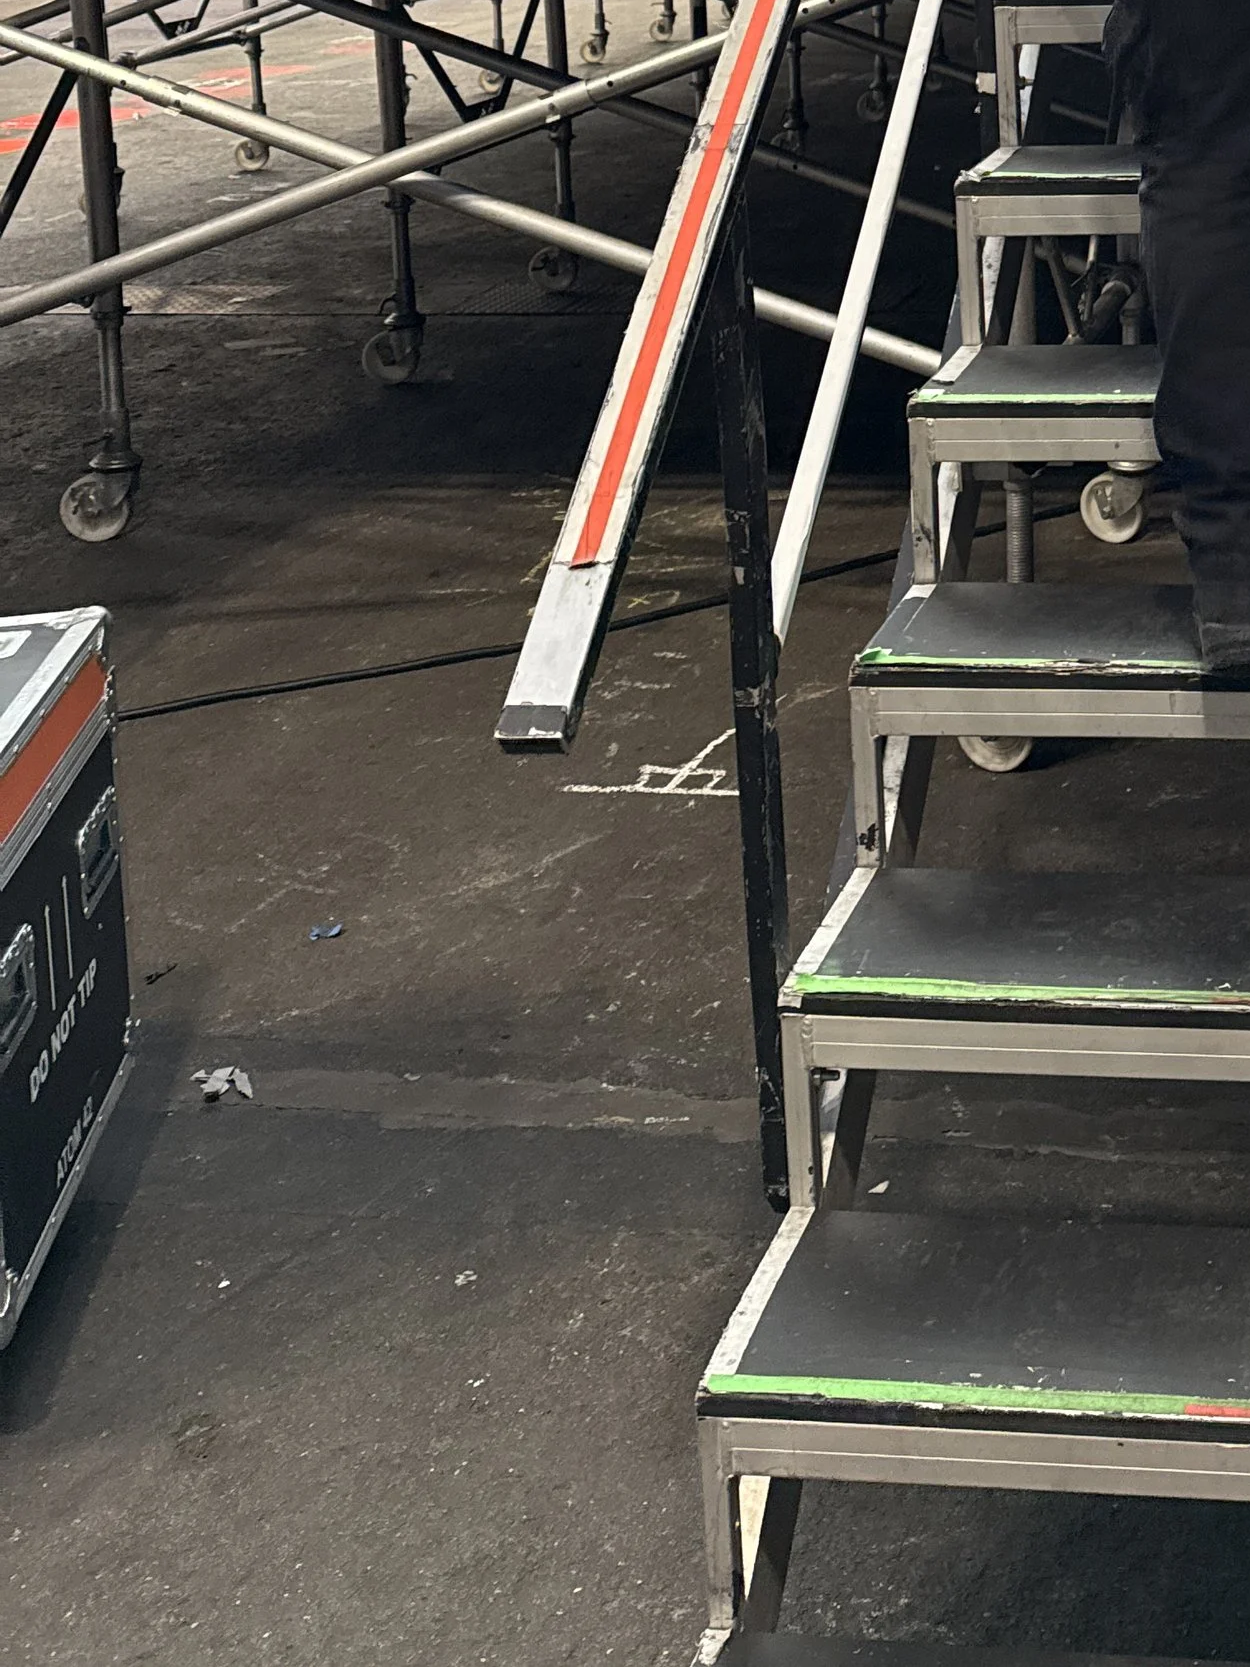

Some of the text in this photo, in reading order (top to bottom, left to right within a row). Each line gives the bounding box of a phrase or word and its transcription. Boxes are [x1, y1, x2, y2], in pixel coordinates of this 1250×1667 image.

[30, 957, 97, 1103] DO NOT TIP
[57, 1118, 82, 1189] ATOM
